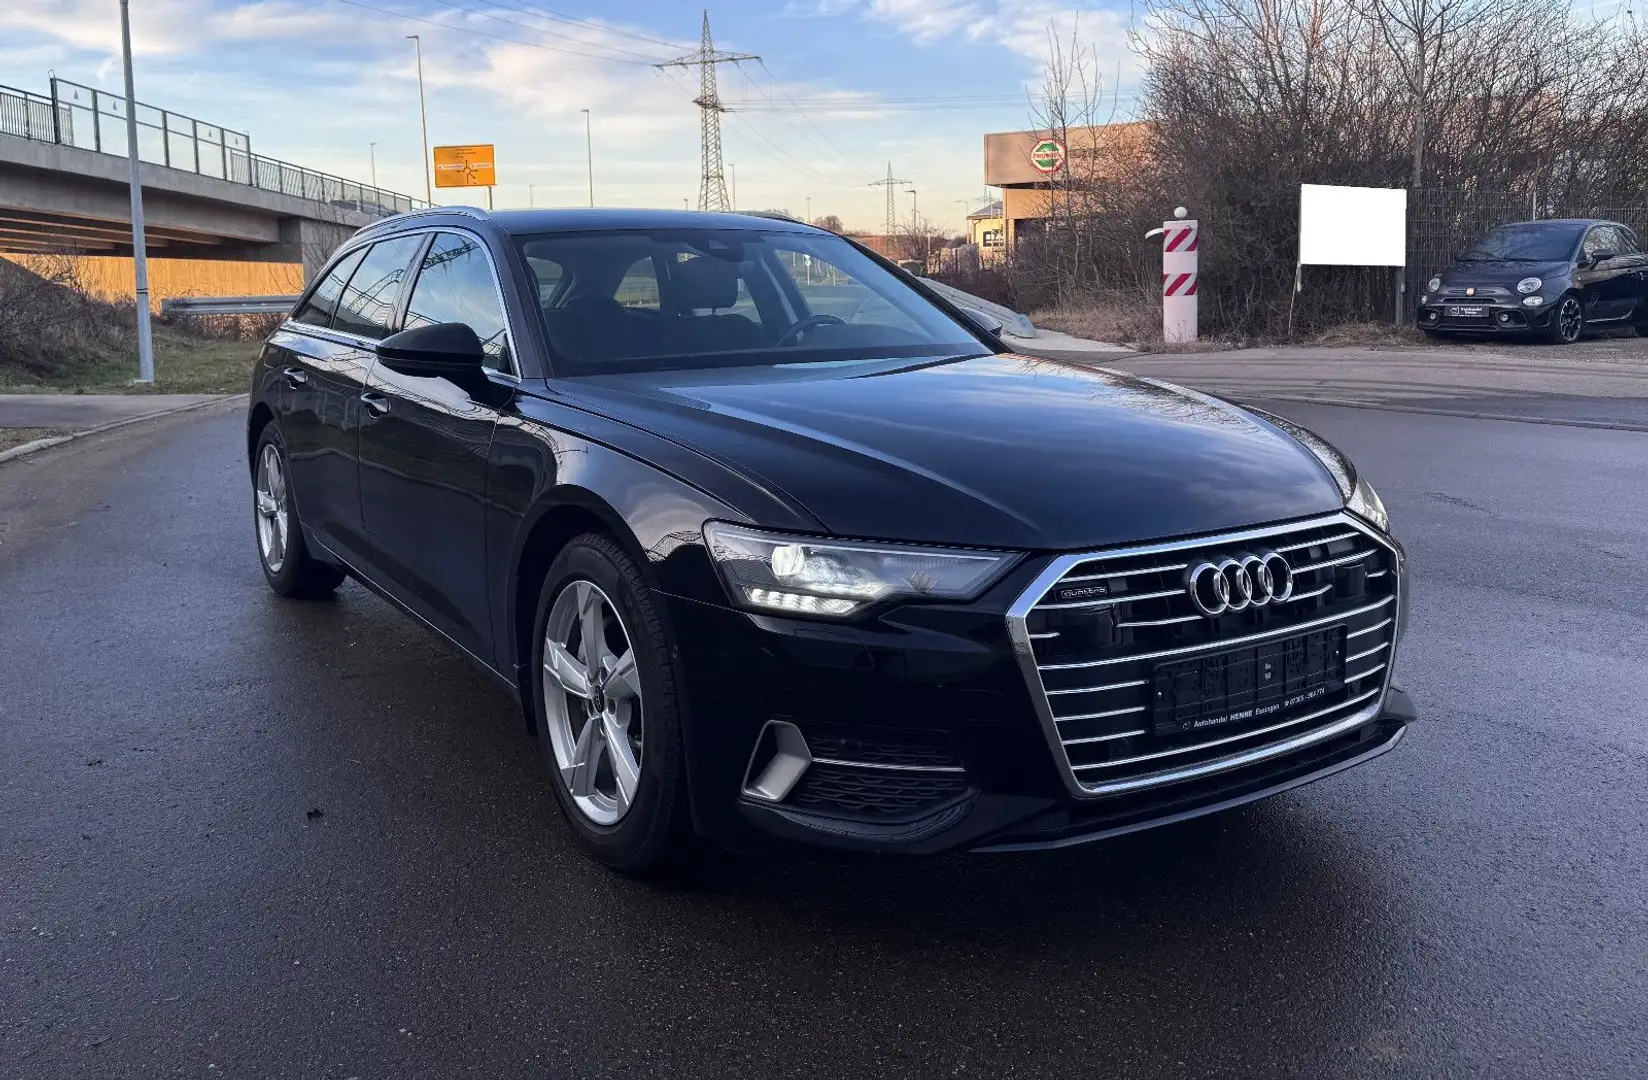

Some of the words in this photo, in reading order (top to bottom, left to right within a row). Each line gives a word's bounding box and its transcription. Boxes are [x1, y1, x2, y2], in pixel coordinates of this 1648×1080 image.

[1063, 588, 1106, 598] quattro
[1194, 716, 1228, 728] Autohandel
[1230, 710, 1253, 721] HENNE
[1255, 704, 1280, 715] Essingen
